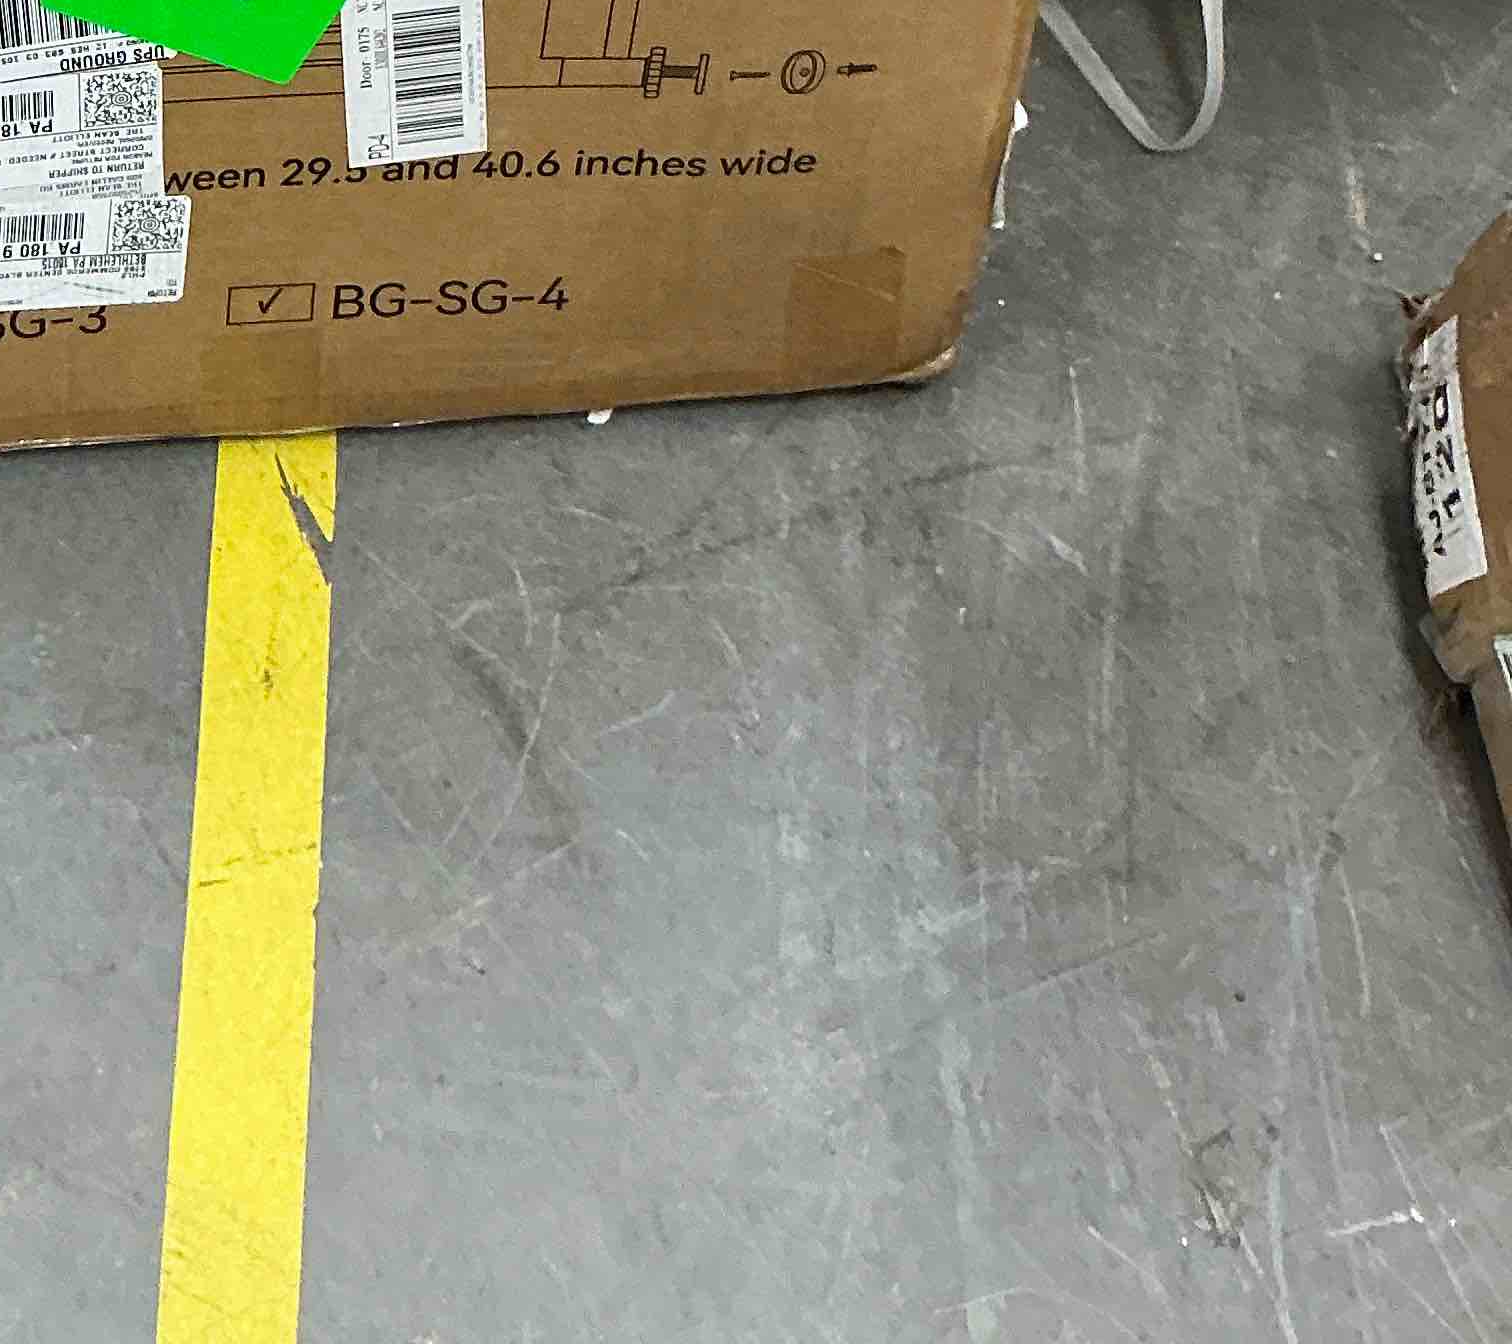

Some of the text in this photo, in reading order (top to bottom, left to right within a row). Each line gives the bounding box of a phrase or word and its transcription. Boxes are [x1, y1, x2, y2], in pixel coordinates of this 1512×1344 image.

[357, 26, 371, 52] 0175
[58, 43, 165, 72] UPS GROUND
[27, 118, 53, 134] PA
[98, 142, 144, 155] CORRECT
[47, 160, 144, 179] RETURN TO SHIPPER
[163, 163, 266, 193] ween
[280, 157, 370, 187] 29.5
[382, 151, 458, 183] and
[472, 149, 561, 179] 40.6
[573, 146, 707, 178] inches
[718, 146, 817, 176] wide
[20, 242, 48, 257] 180
[58, 240, 81, 254] PA
[71, 256, 86, 268] PA
[88, 252, 146, 267] BETHLEHEM
[330, 276, 570, 322] BG-SG-4
